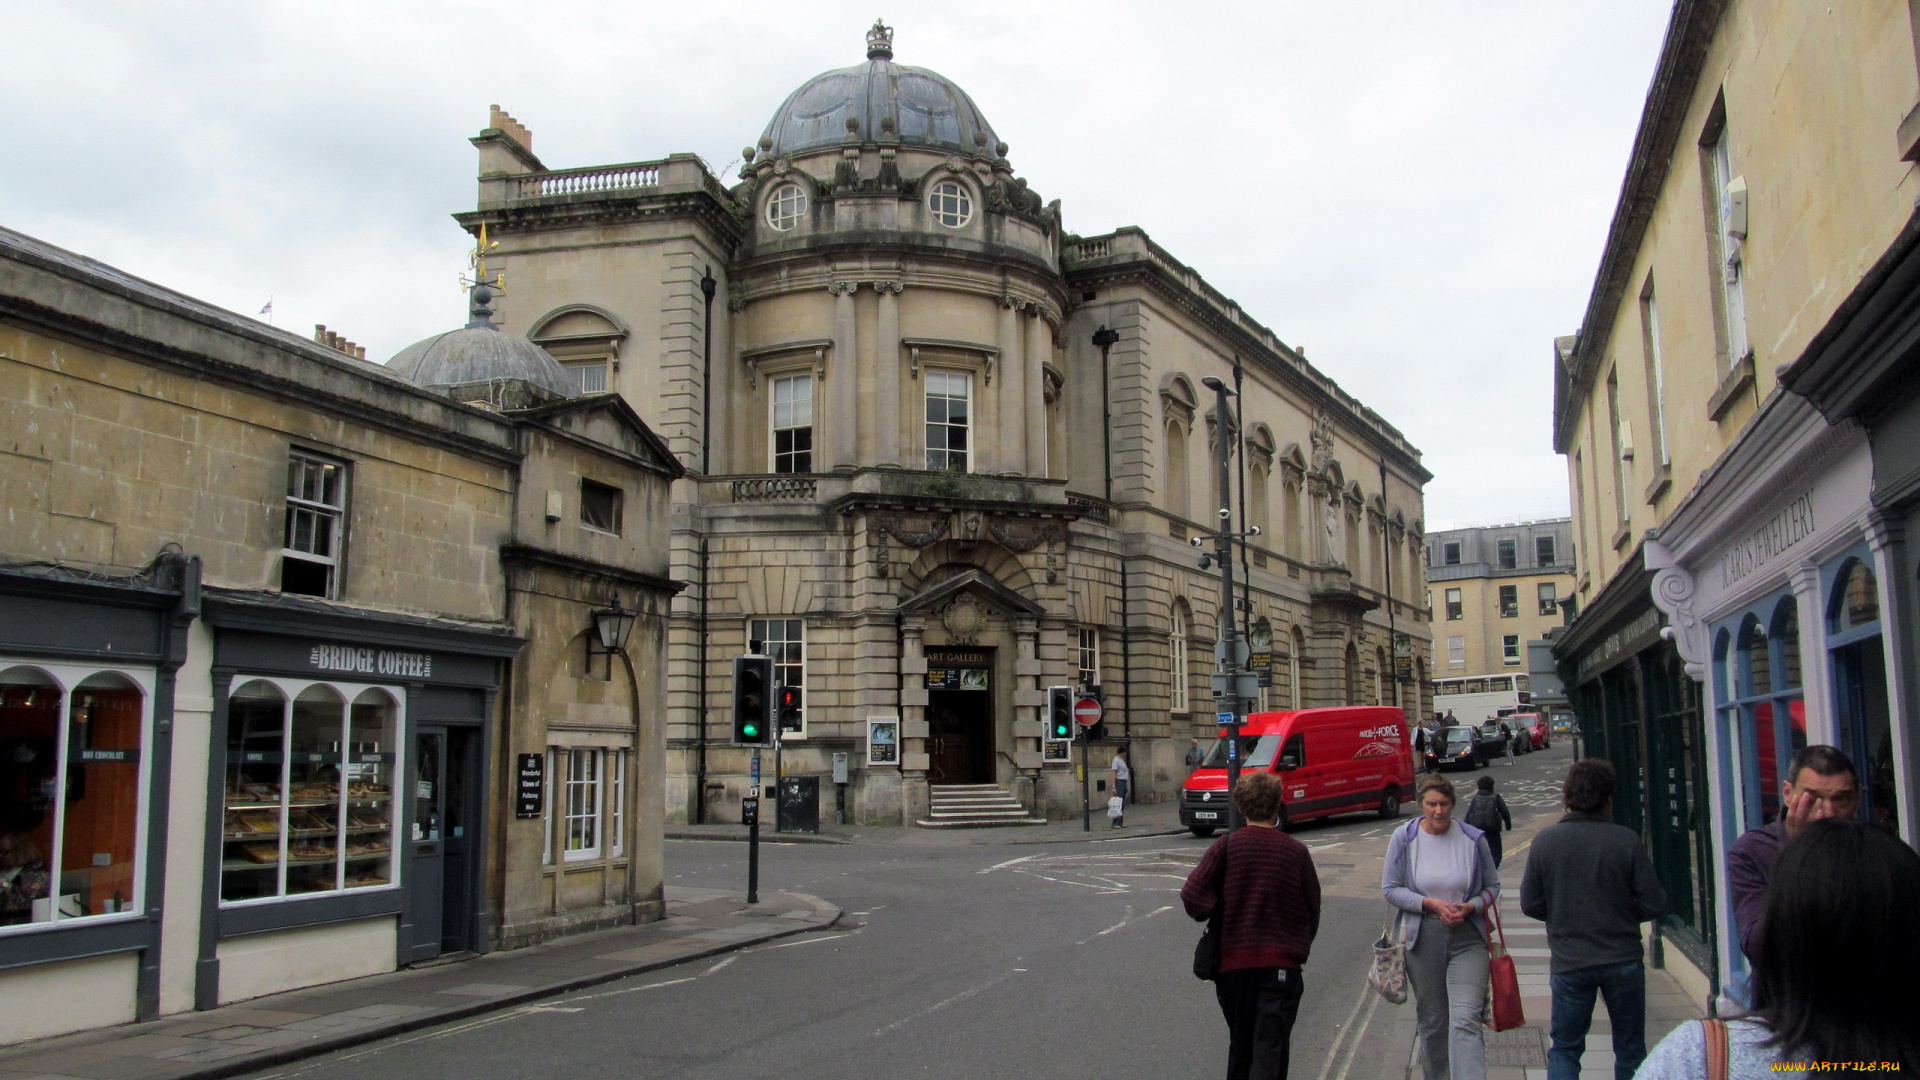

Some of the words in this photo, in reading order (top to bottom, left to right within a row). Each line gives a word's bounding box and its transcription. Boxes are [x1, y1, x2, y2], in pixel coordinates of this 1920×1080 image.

[1721, 537, 1753, 590] ICARUS
[1753, 487, 1816, 570] JEWELLERY
[310, 647, 319, 664] the
[318, 645, 374, 673] BRIDGE
[378, 651, 423, 676] COFFEE
[928, 653, 944, 661] ART
[947, 653, 984, 661] GALLERY
[95, 751, 124, 760] CHOCOLATE
